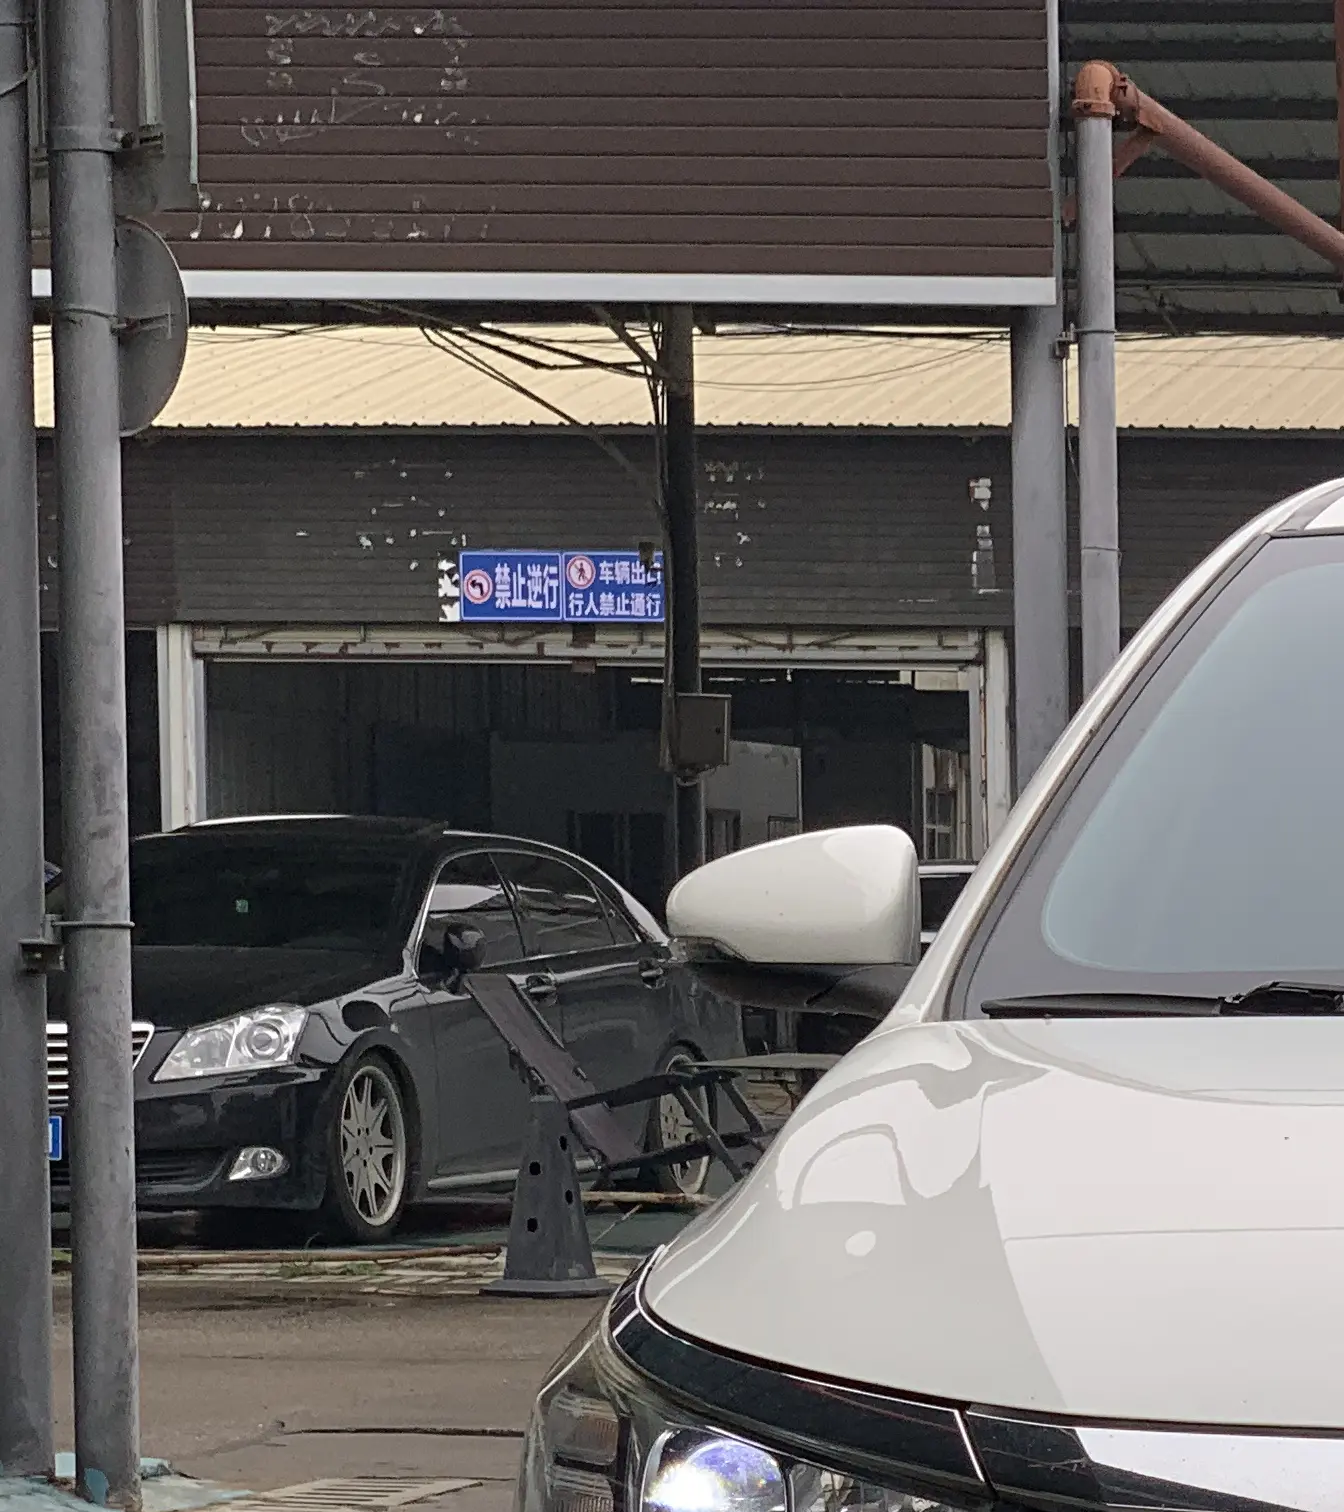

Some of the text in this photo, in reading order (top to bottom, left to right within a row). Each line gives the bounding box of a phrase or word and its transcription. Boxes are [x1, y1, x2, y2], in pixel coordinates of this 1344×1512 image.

[495, 562, 559, 610] 禁止逆行
[569, 592, 661, 617] 行人禁止通行
